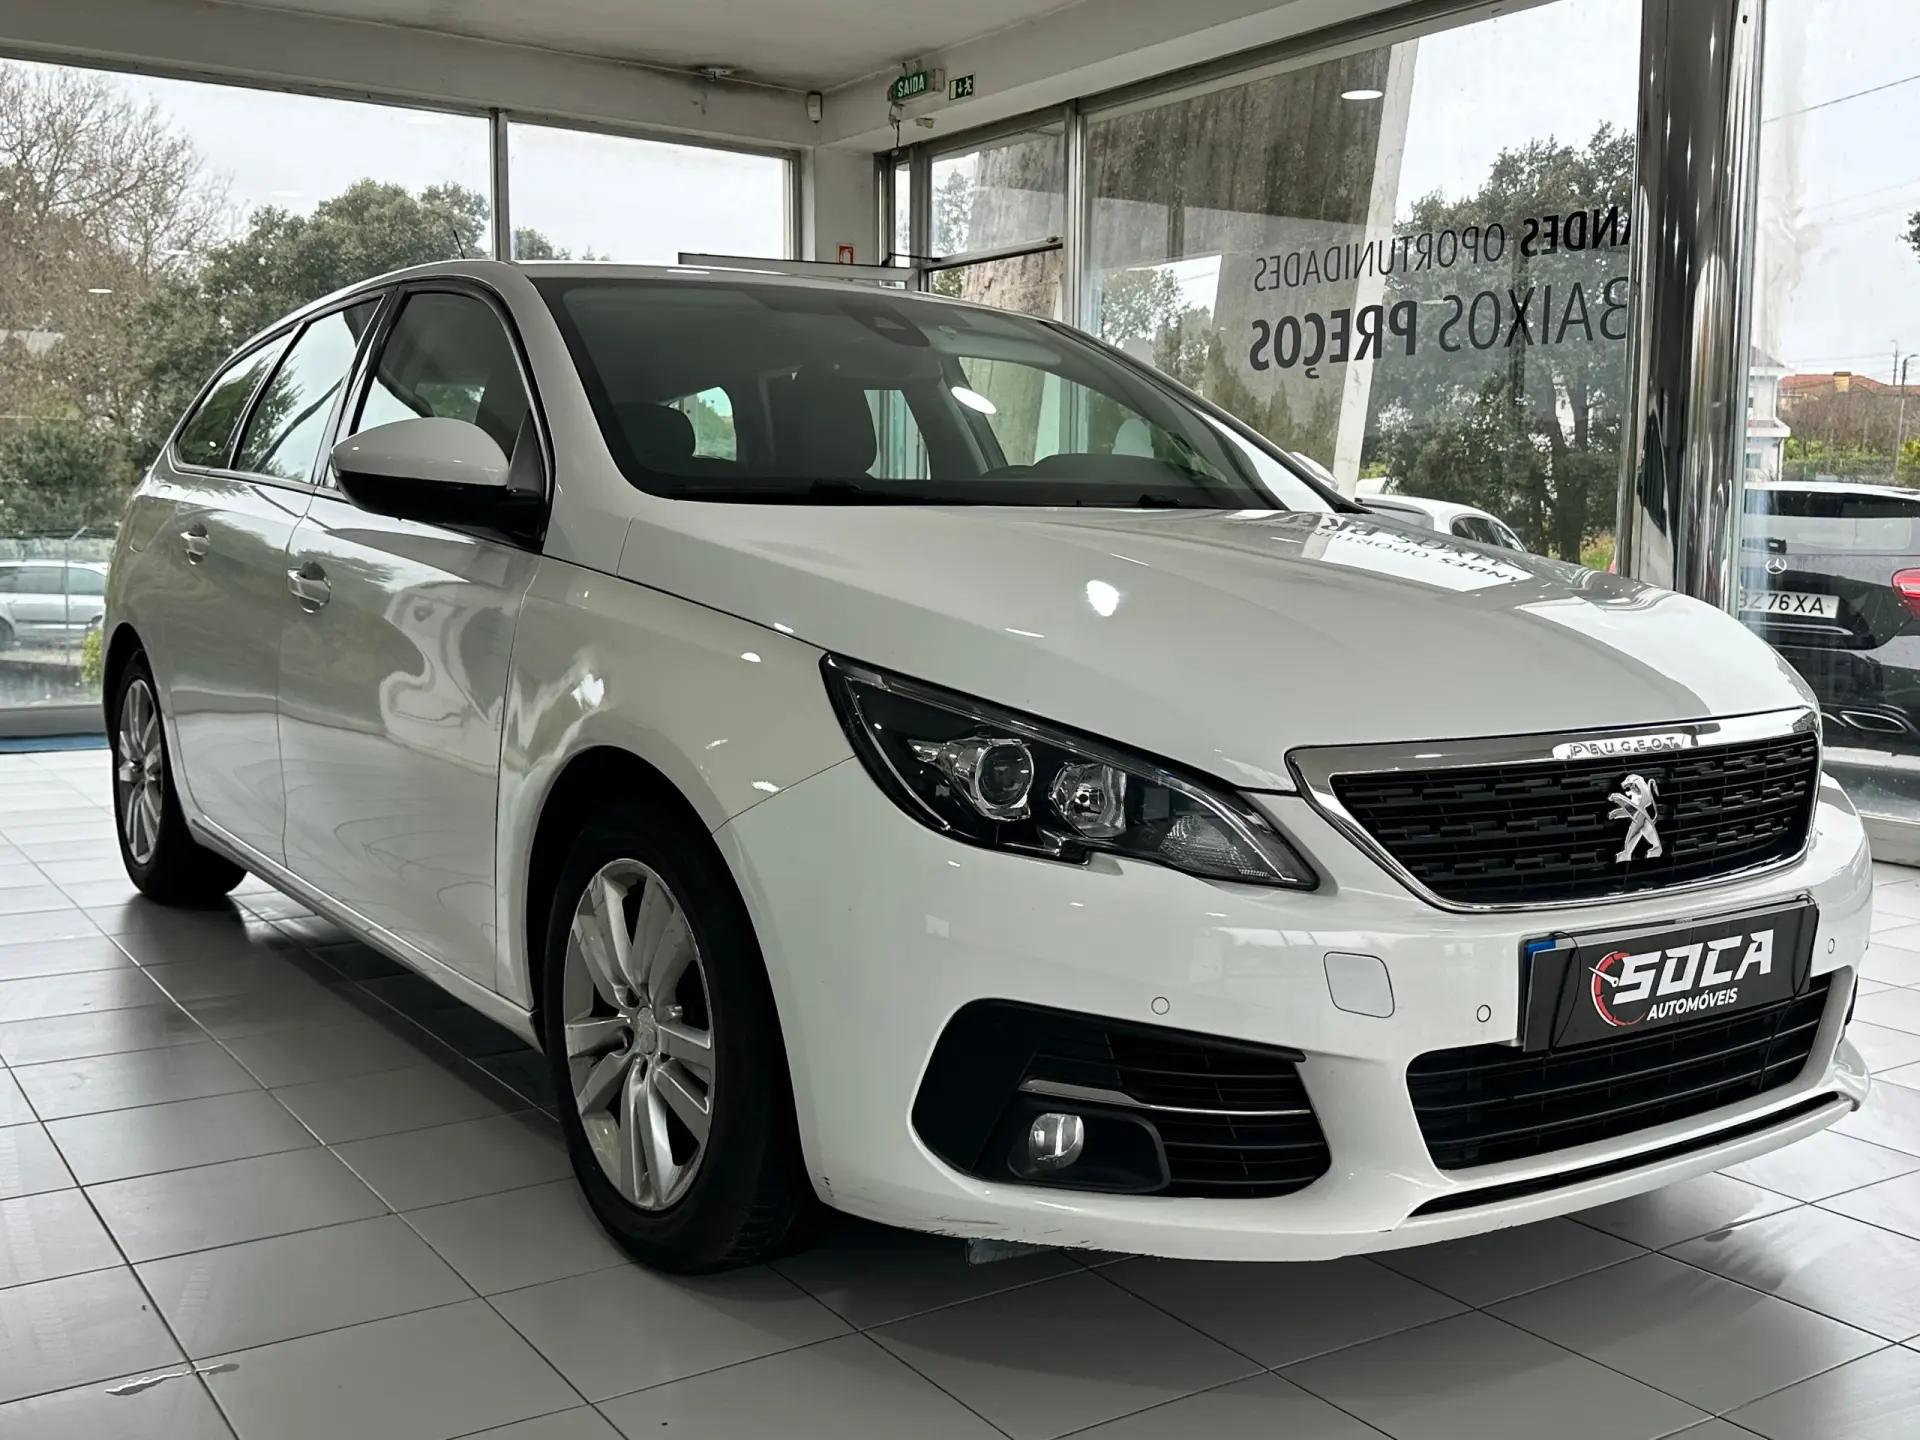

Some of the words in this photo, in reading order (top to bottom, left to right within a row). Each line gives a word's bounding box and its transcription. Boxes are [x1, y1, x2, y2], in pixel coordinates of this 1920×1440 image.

[1768, 593, 1791, 611] 76
[1793, 594, 1824, 614] XA
[1570, 736, 1676, 757] PEUGEOT
[1612, 929, 1774, 1005] SOCA
[1646, 987, 1738, 1021] AUTOMÓVEIS
